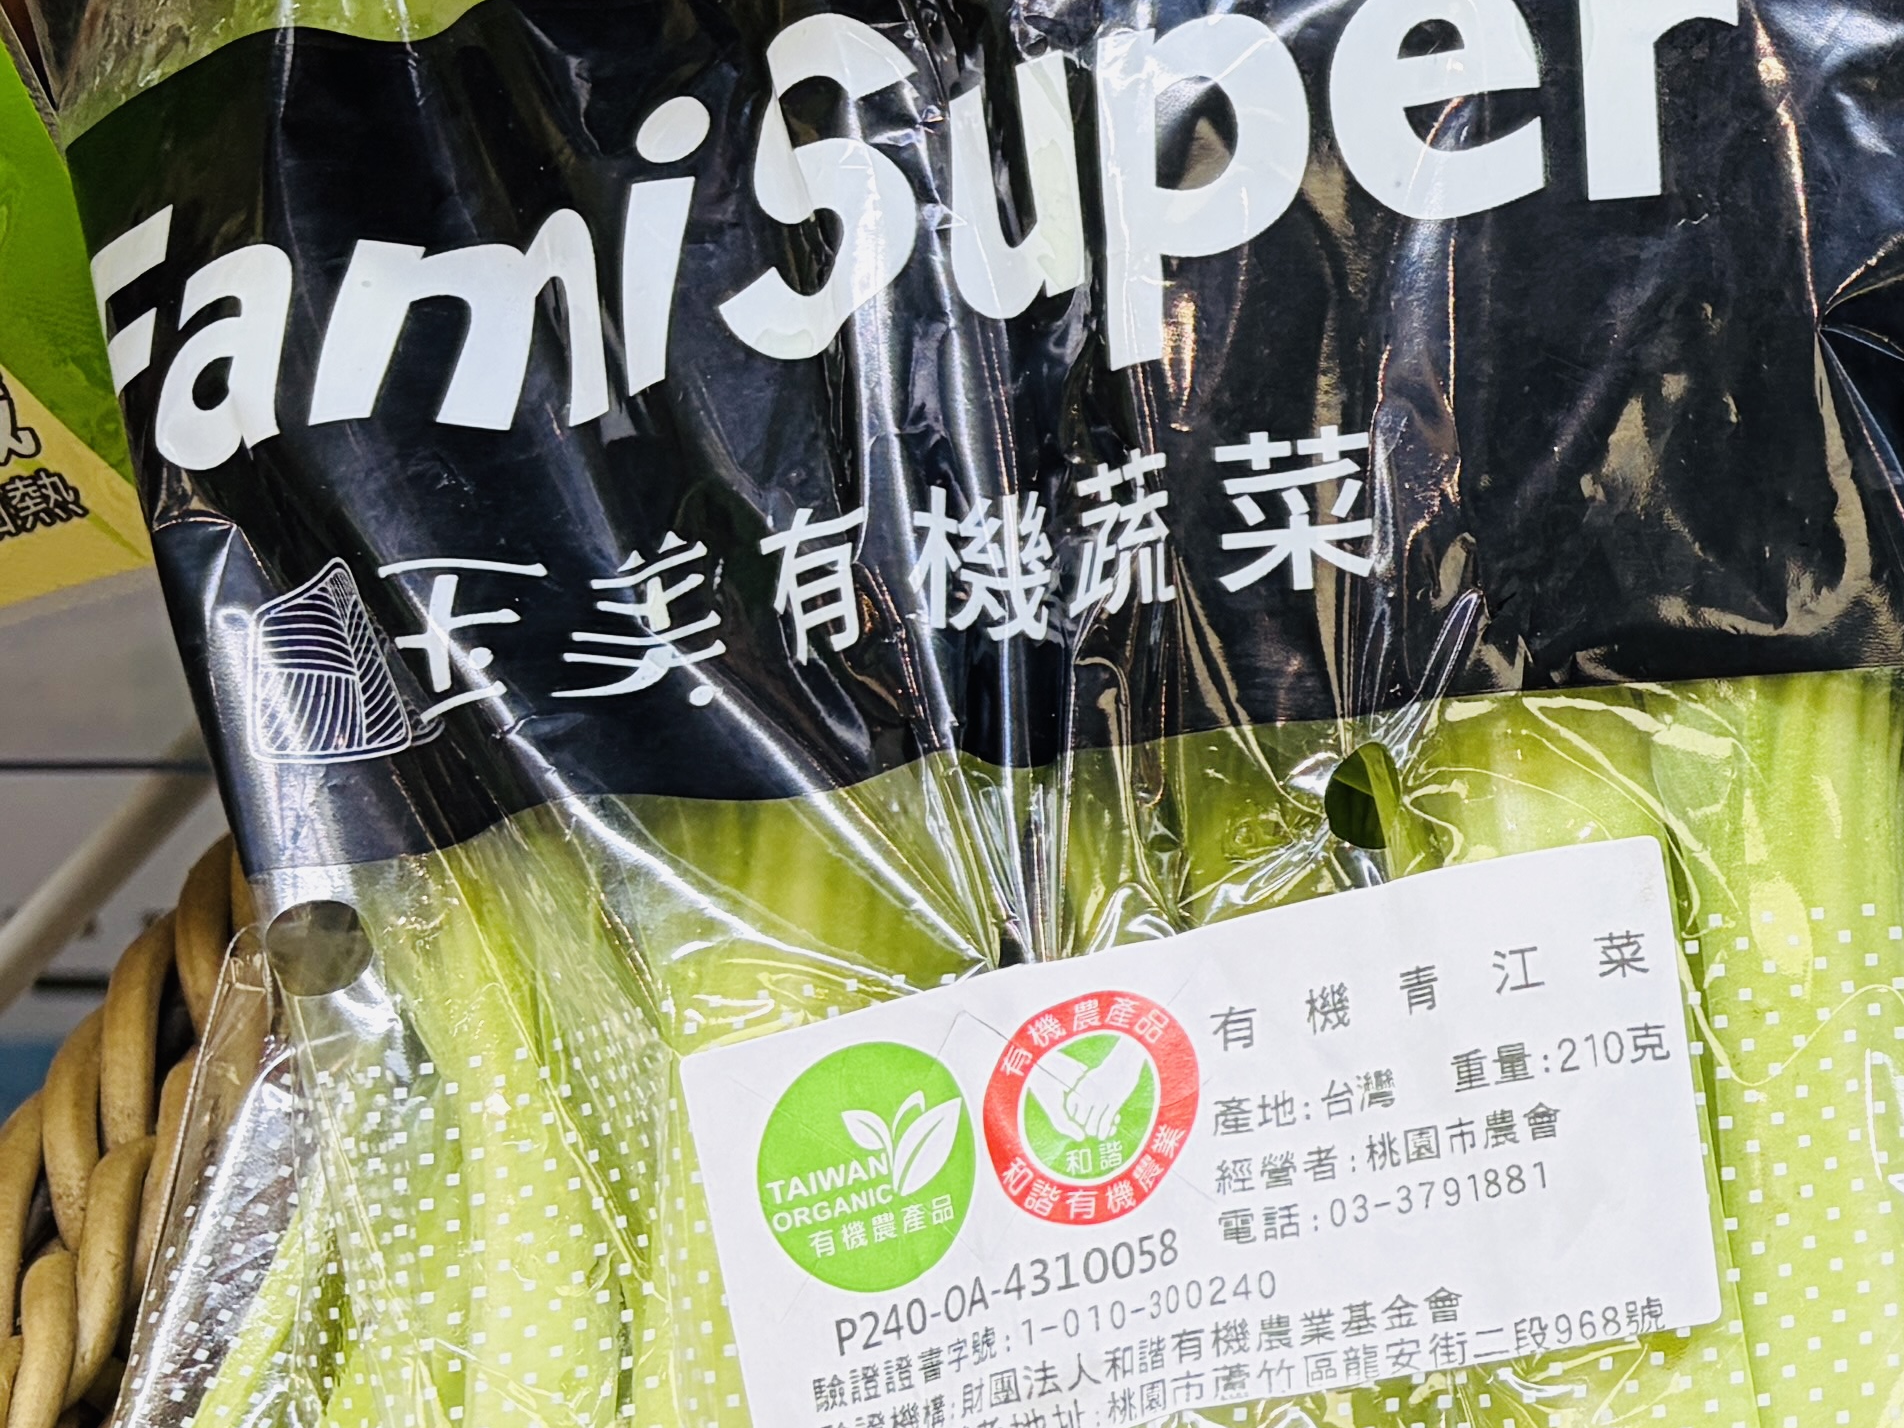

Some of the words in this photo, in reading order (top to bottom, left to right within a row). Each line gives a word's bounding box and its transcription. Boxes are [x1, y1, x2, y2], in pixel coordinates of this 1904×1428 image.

[766, 1152, 890, 1205] TAIWAN
[1065, 1139, 1123, 1176] 和諧
[771, 1183, 893, 1234] ORGANIC
[808, 1194, 955, 1259] 有機農產品
